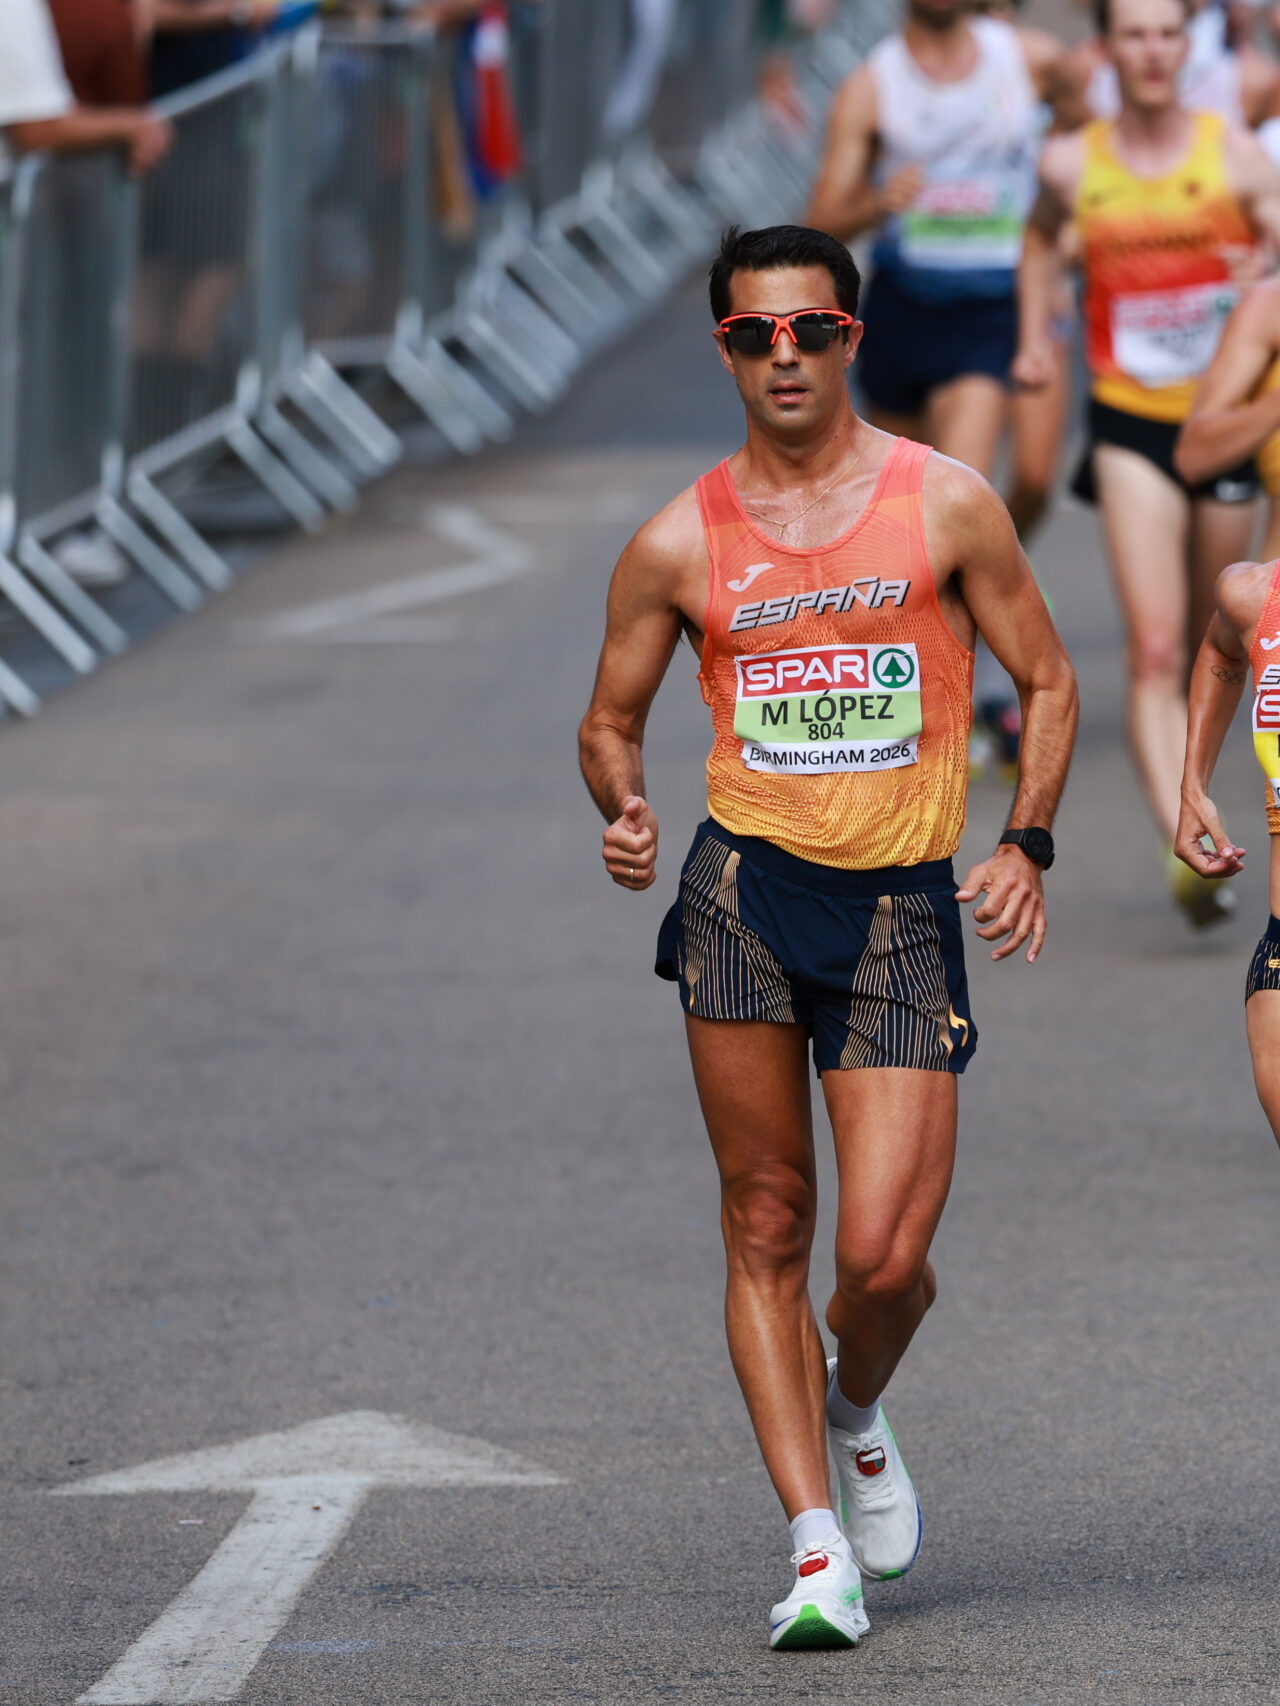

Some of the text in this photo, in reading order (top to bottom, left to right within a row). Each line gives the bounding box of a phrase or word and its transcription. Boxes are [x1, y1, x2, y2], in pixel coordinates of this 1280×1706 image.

[729, 576, 911, 633] ESPAÑA
[746, 654, 866, 691] SPAR
[761, 689, 894, 726] M LÓPEZ
[807, 722, 845, 741] 804
[749, 743, 910, 766] BIRMINGHAM 2026
